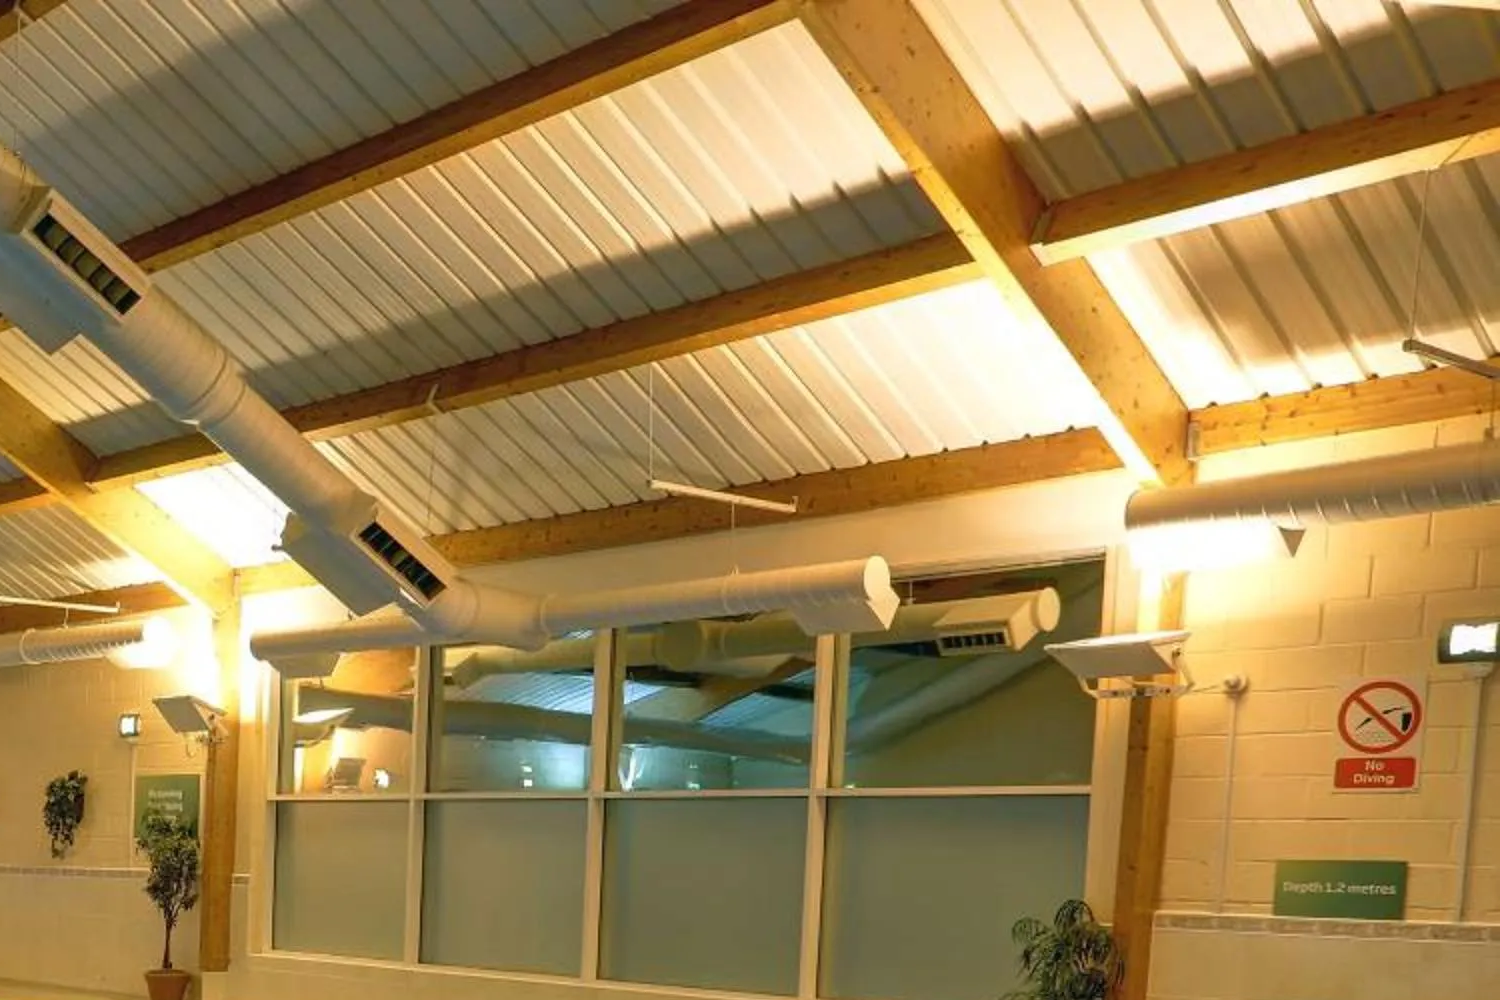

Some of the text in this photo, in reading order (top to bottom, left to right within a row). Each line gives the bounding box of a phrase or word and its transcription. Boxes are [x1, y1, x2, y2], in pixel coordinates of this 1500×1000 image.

[1364, 760, 1385, 771] No
[1353, 773, 1395, 784] Diving
[1283, 881, 1396, 895] Depth 1.2 metres
